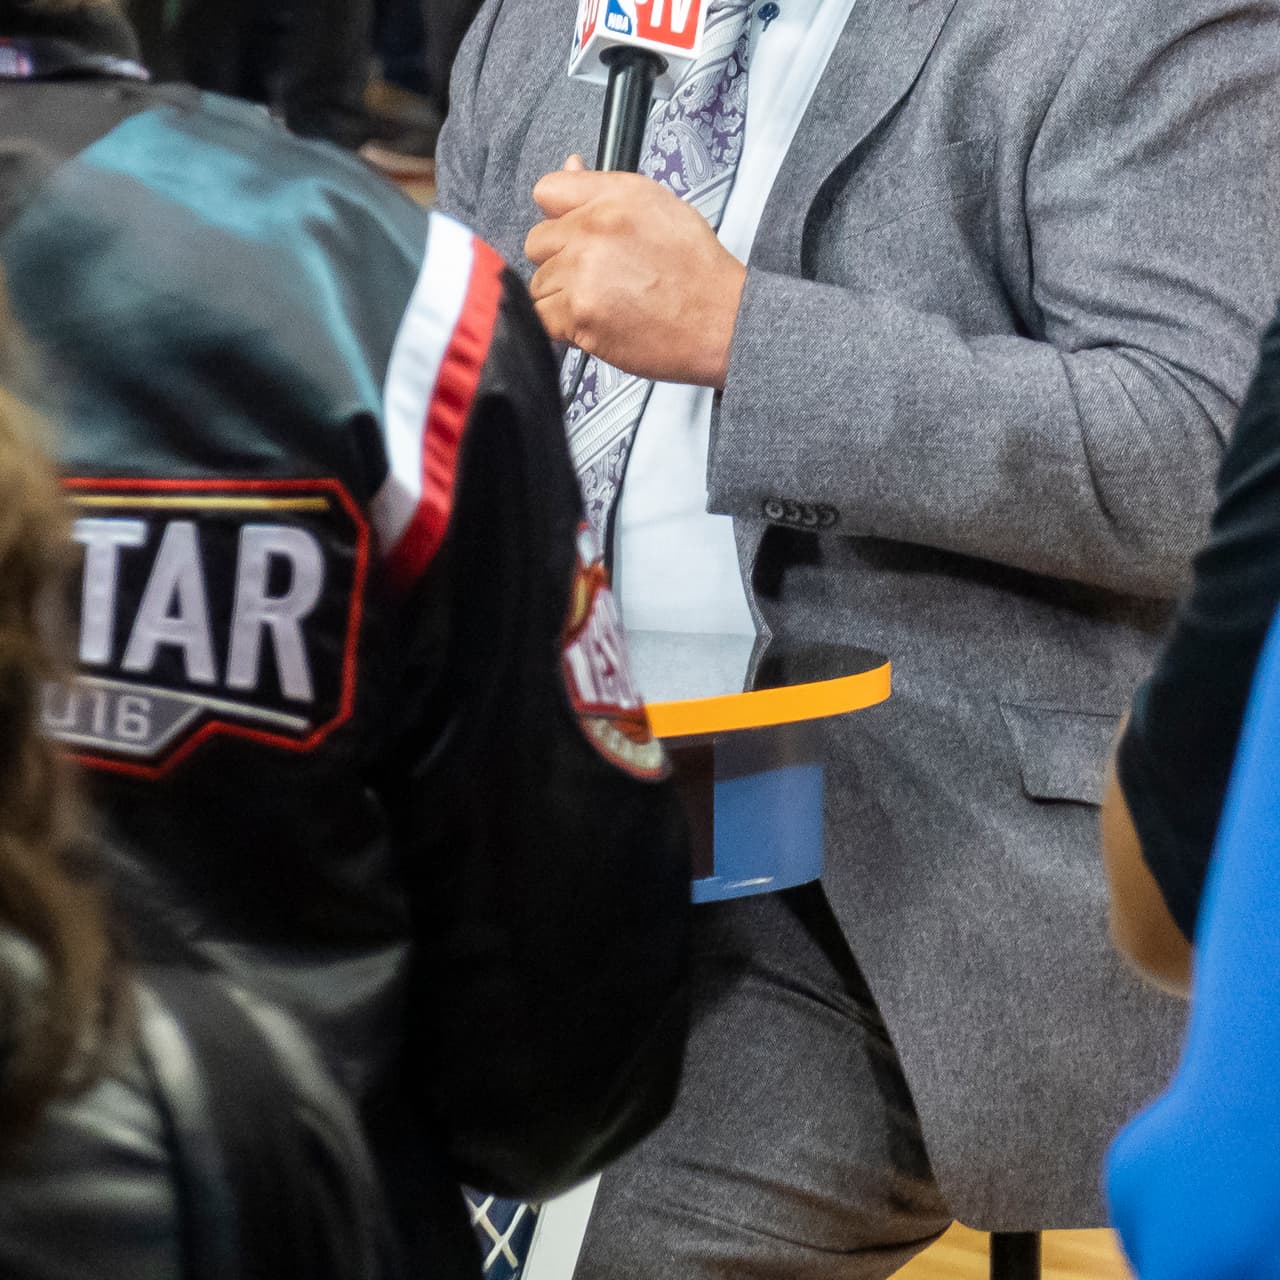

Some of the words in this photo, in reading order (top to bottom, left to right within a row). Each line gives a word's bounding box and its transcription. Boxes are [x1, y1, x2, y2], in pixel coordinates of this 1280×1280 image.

[607, 12, 629, 33] NBA
[72, 517, 325, 703] TAR
[40, 681, 152, 742] 016
